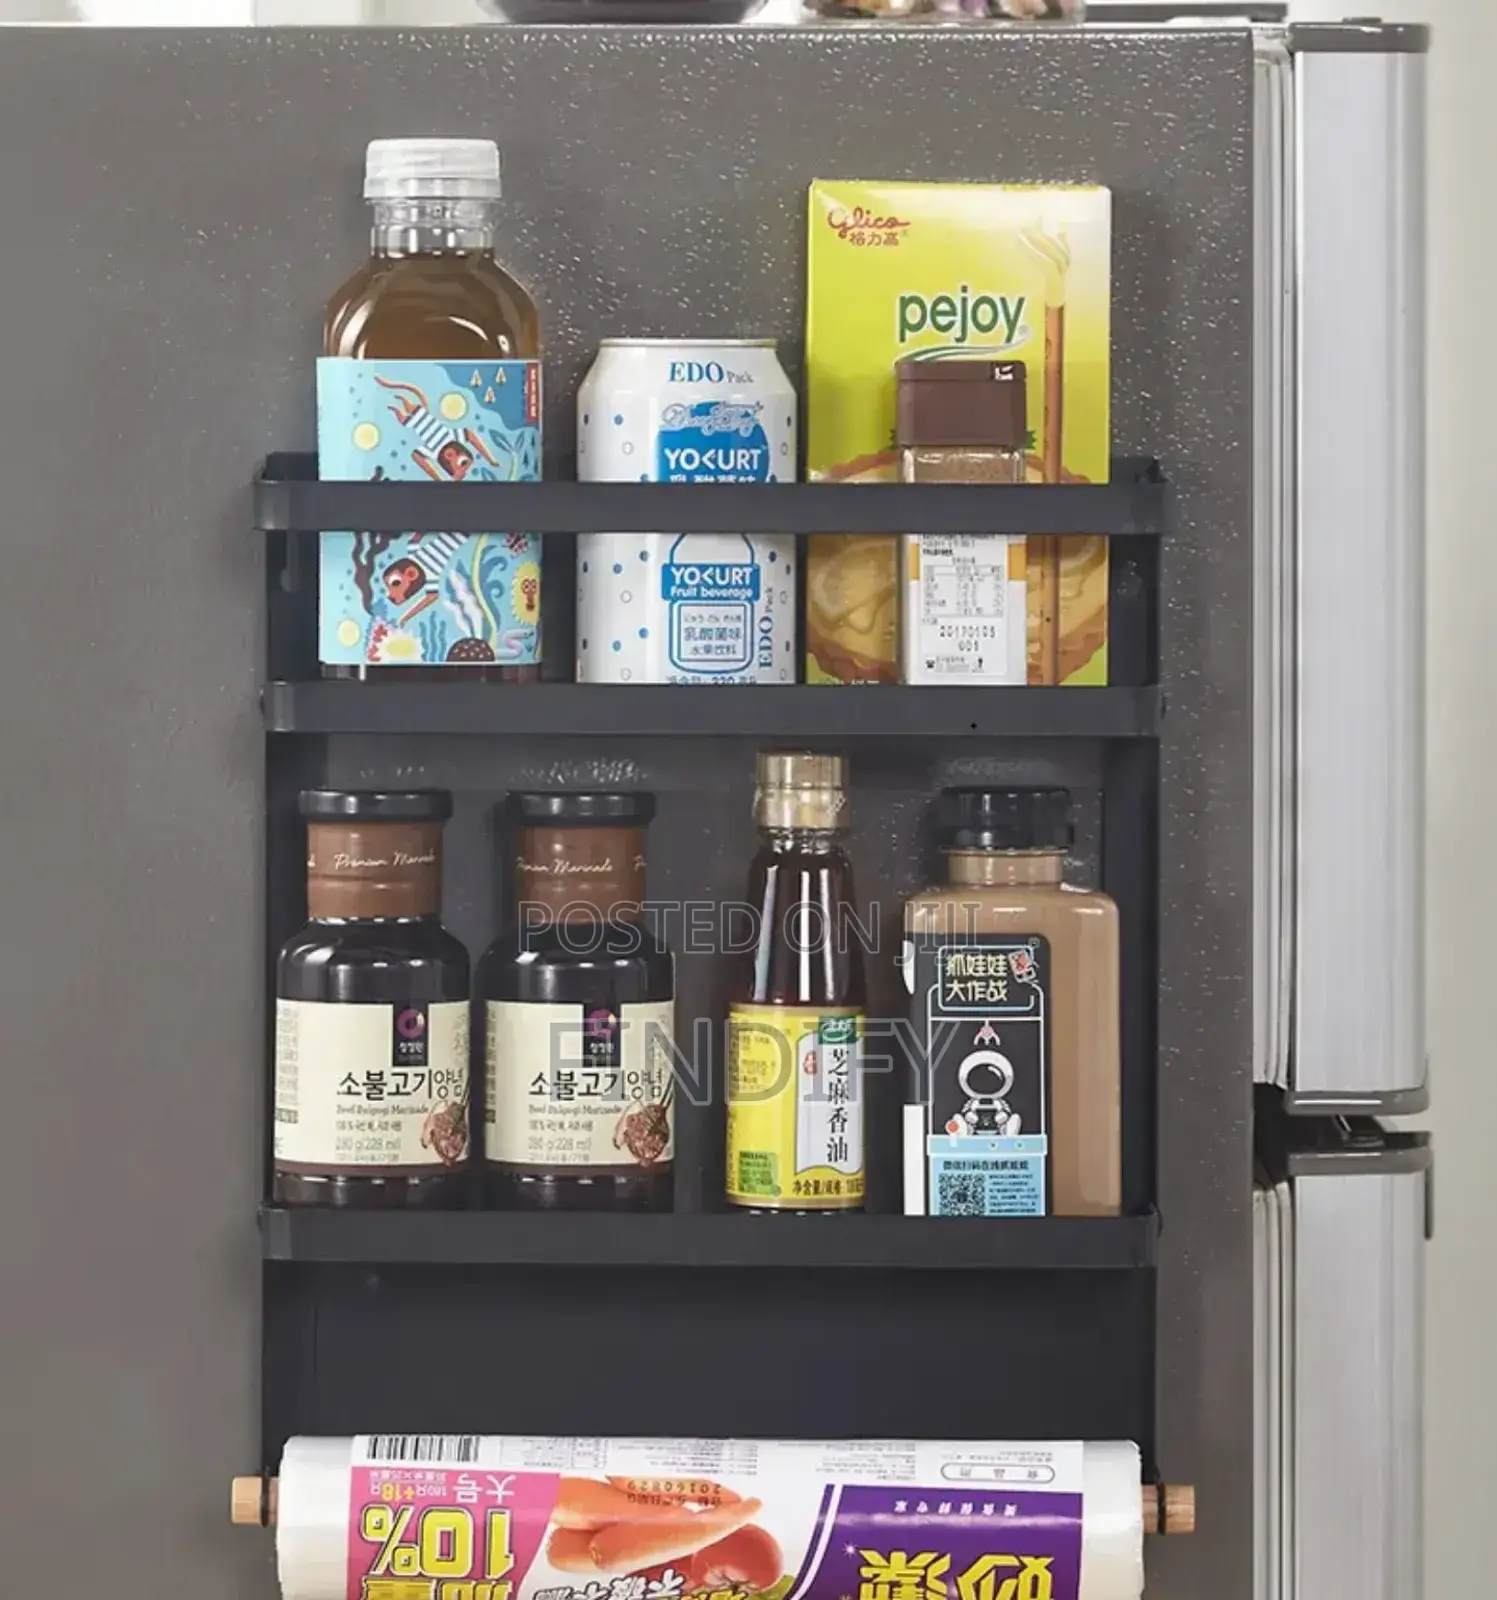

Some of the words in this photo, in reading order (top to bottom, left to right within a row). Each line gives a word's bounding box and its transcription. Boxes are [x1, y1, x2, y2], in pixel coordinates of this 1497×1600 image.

[827, 206, 911, 239] Glico
[849, 231, 899, 246] 格力高
[898, 285, 1025, 343] pejoy
[668, 361, 724, 383] EDO
[727, 371, 754, 383] Pack
[671, 587, 697, 597] Fruit
[701, 586, 753, 599] beverage
[945, 953, 1008, 978] 抓娃娃
[945, 980, 1008, 1002] 大作战
[828, 1048, 849, 1163] 芝麻香油
[453, 1474, 516, 1504] 大号
[360, 1503, 515, 1579] 10%
